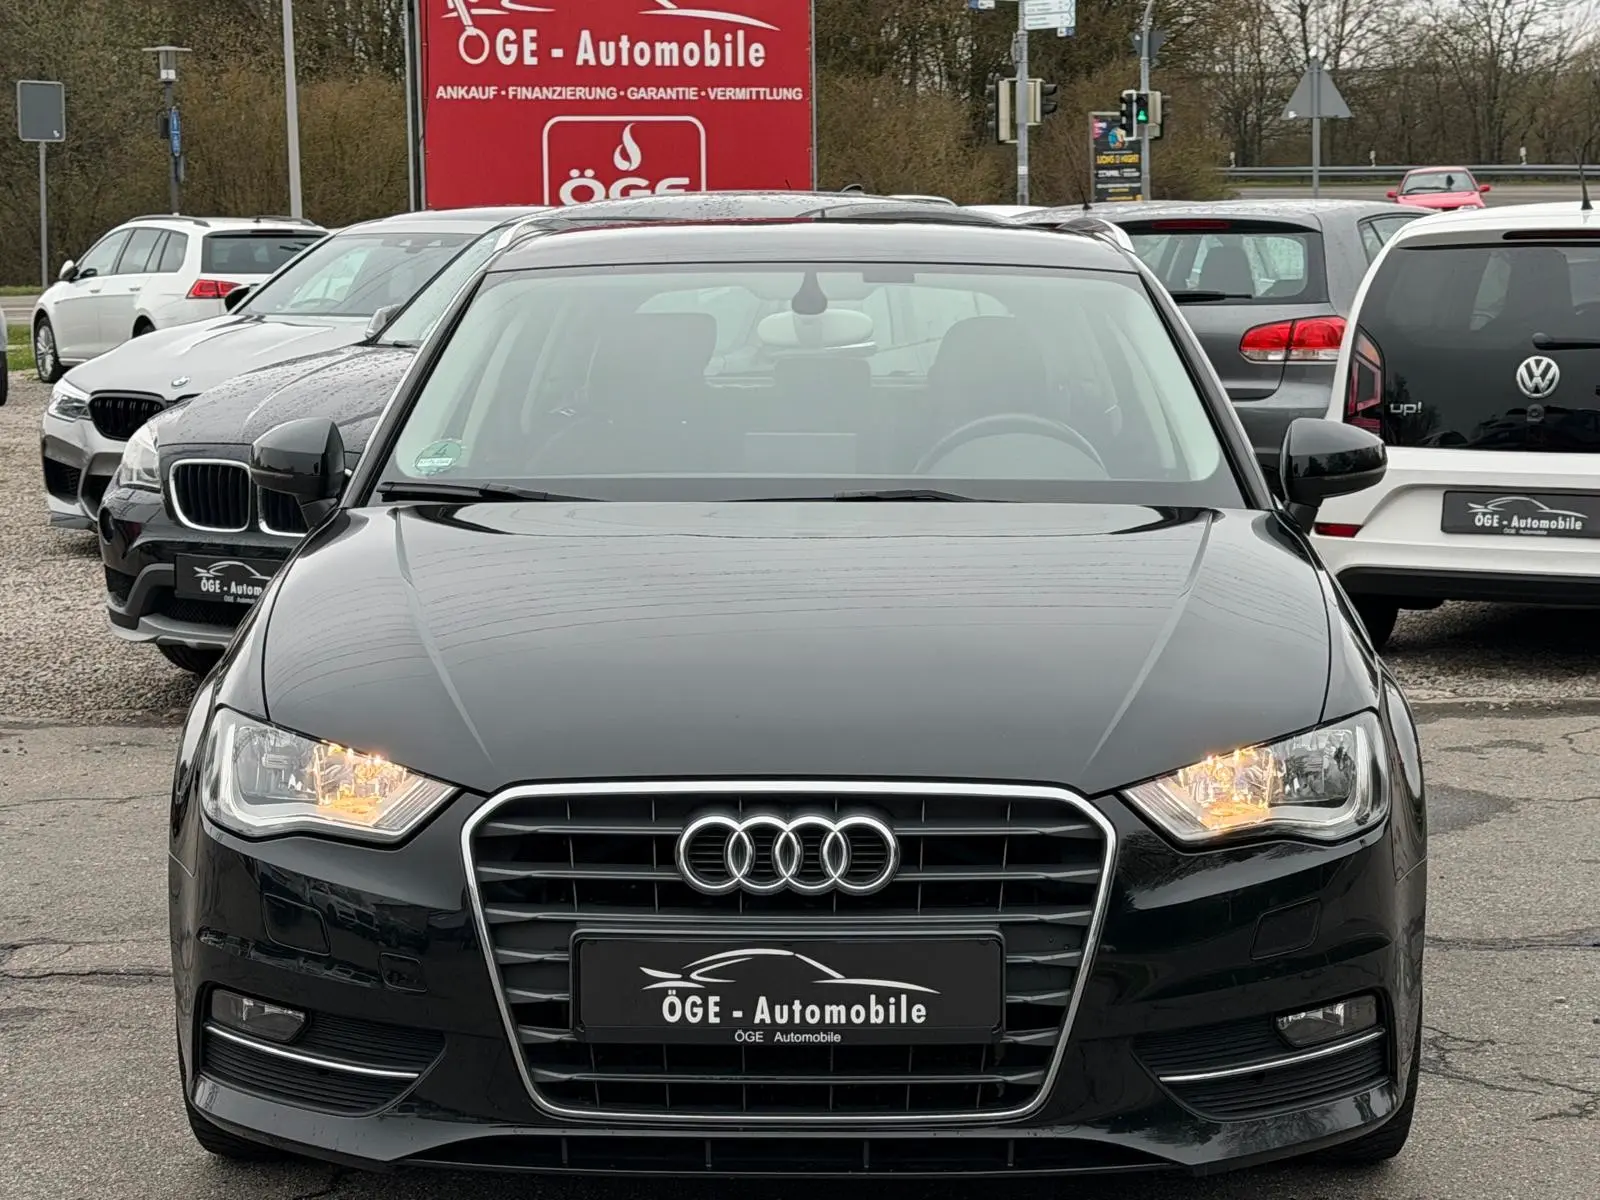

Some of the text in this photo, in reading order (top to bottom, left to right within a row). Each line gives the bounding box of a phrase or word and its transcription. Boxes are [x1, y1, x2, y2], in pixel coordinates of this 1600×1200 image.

[576, 29, 766, 68] Automobile
[435, 86, 804, 101] ANKAUF FINANZIERUNG GARANTIE VERMITTLUNG
[1389, 401, 1423, 417] up!
[1474, 512, 1500, 528] ÖGE
[1511, 514, 1583, 531] Automobile
[200, 577, 221, 593] ÖGE
[230, 581, 263, 596] Autom
[662, 990, 721, 1025] ÖGE
[753, 993, 928, 1026] Automobile
[734, 1028, 842, 1044] ÖGE Automobile
